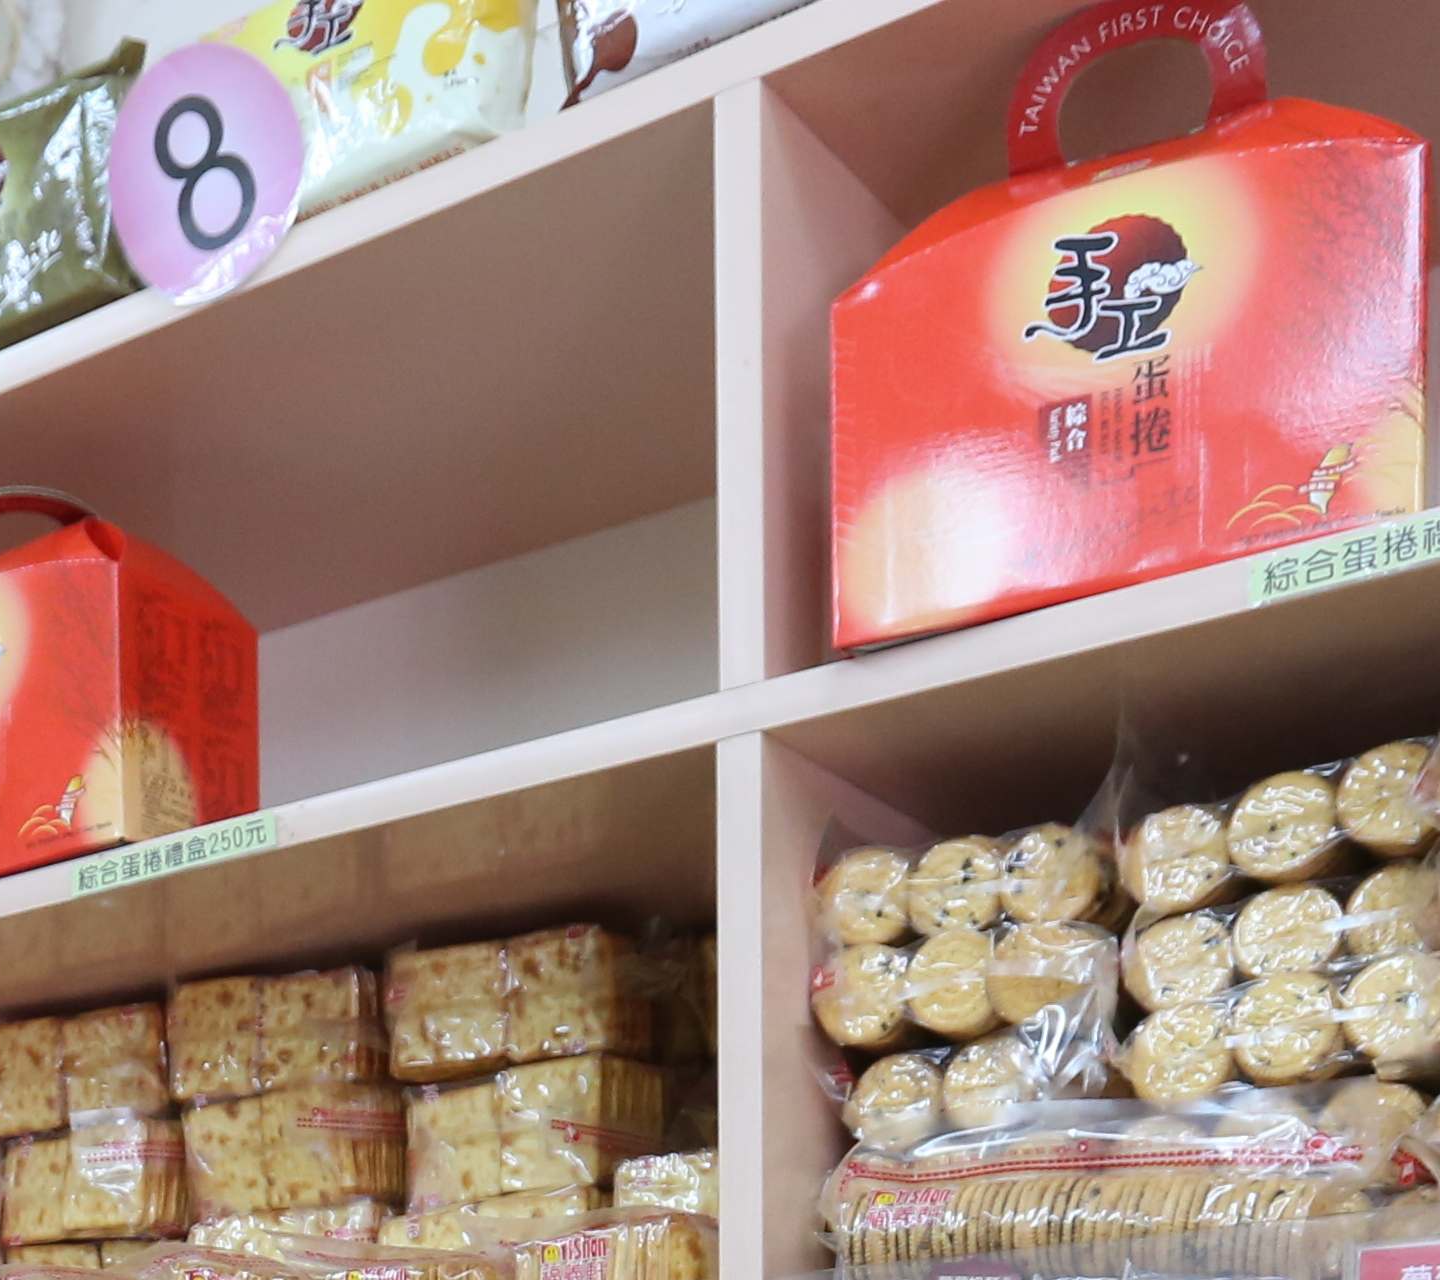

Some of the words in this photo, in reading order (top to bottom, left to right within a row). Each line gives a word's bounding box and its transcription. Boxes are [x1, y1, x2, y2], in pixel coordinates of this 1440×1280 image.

[1019, 36, 1092, 137] TAIWAN
[1098, 5, 1164, 45] FIRST
[1173, 6, 1250, 74] CHOICE
[154, 94, 256, 252] 8
[1130, 354, 1172, 458] 蛋捲
[76, 818, 268, 893] 綜合蛋捲禮盒250元
